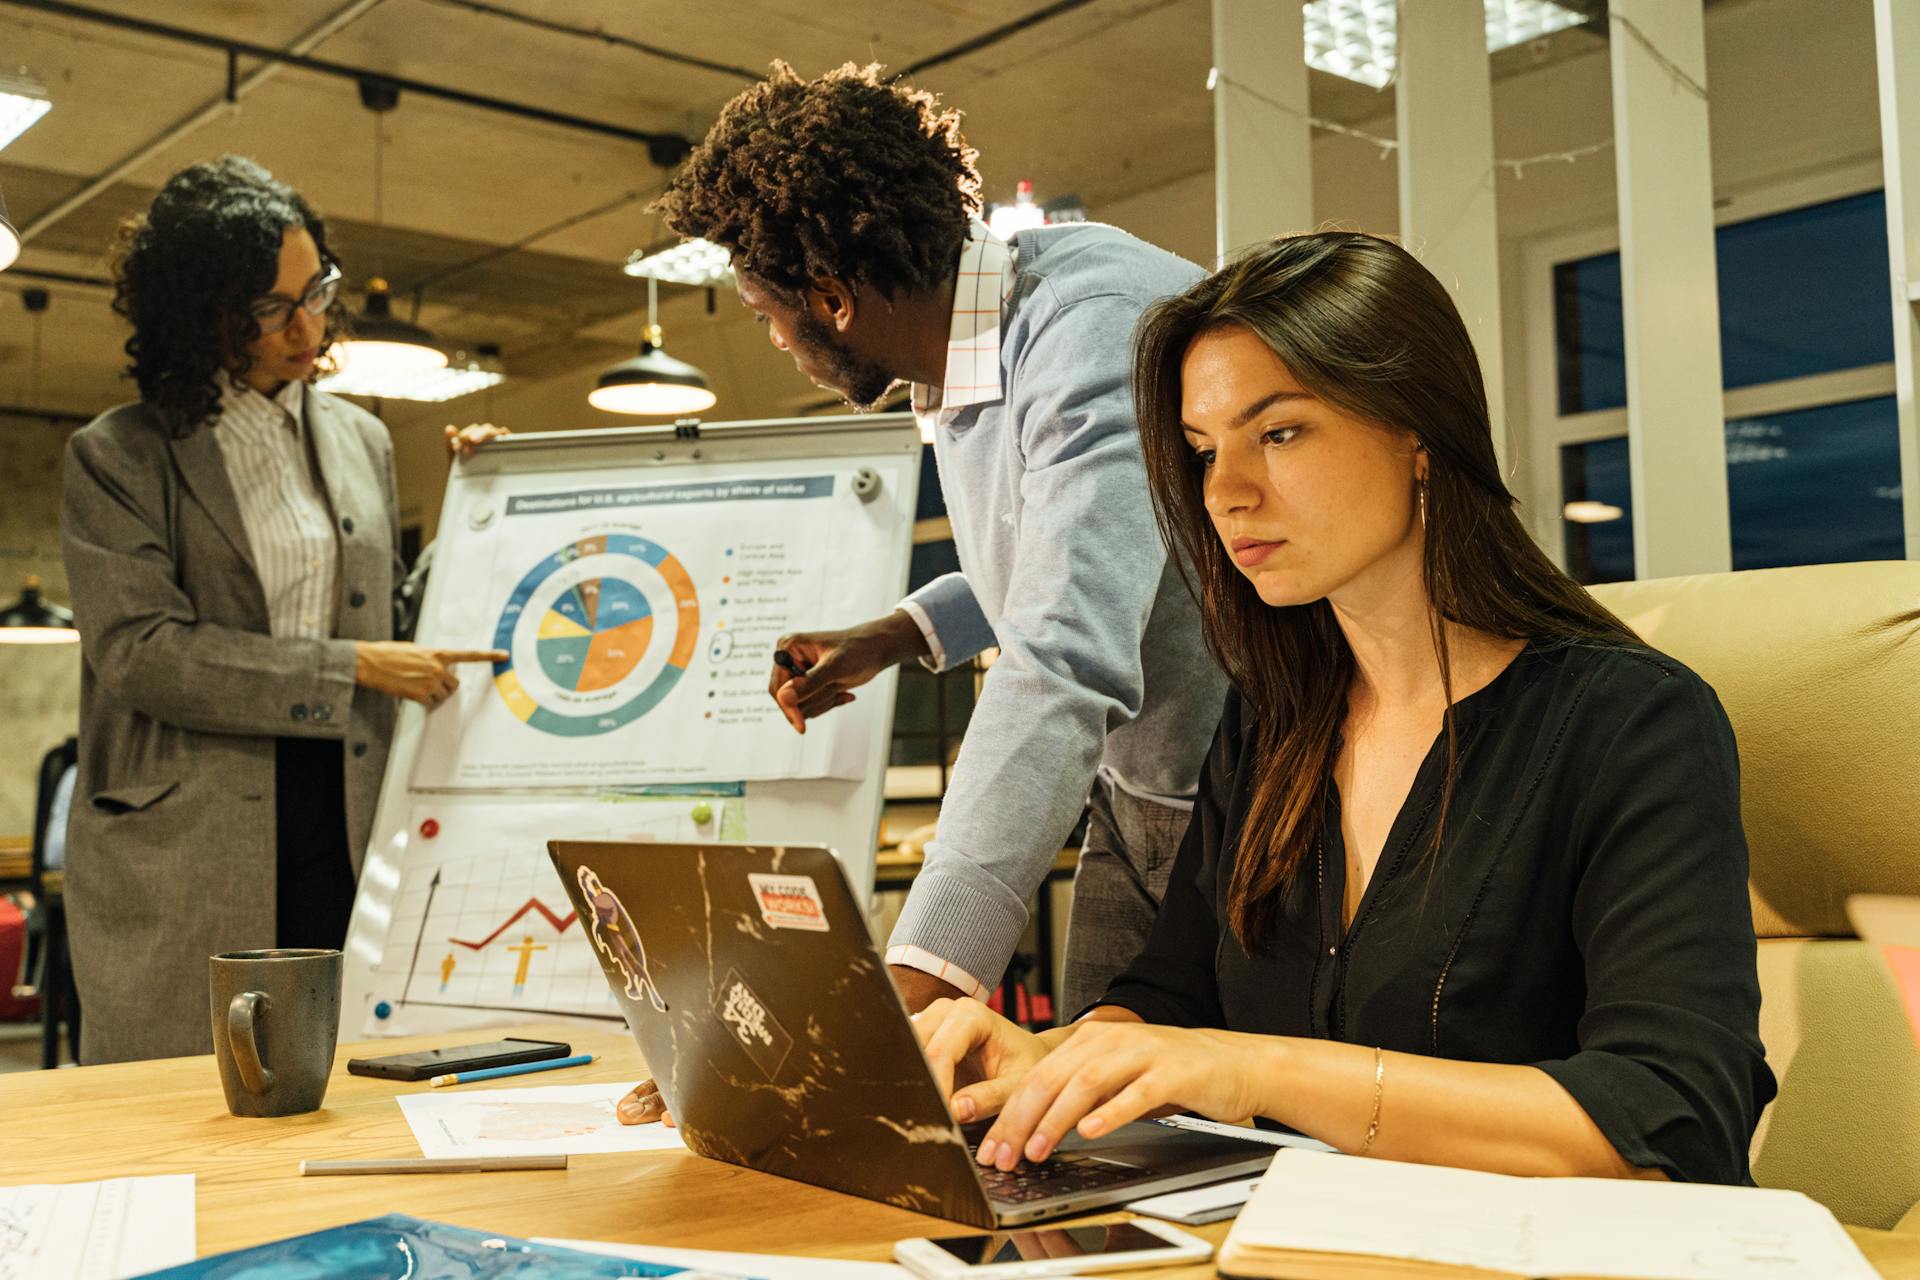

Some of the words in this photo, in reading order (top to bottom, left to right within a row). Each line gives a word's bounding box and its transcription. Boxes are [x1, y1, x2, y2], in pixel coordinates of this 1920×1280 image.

[577, 494, 593, 506] for
[593, 493, 614, 505] U.S.
[616, 489, 675, 505] agricultural
[675, 487, 714, 501] exports
[715, 486, 730, 498] by
[730, 484, 761, 496] share
[761, 484, 775, 495] of
[775, 483, 806, 495] value
[729, 990, 773, 1047] MEDIA
[731, 981, 766, 1022] DAY
